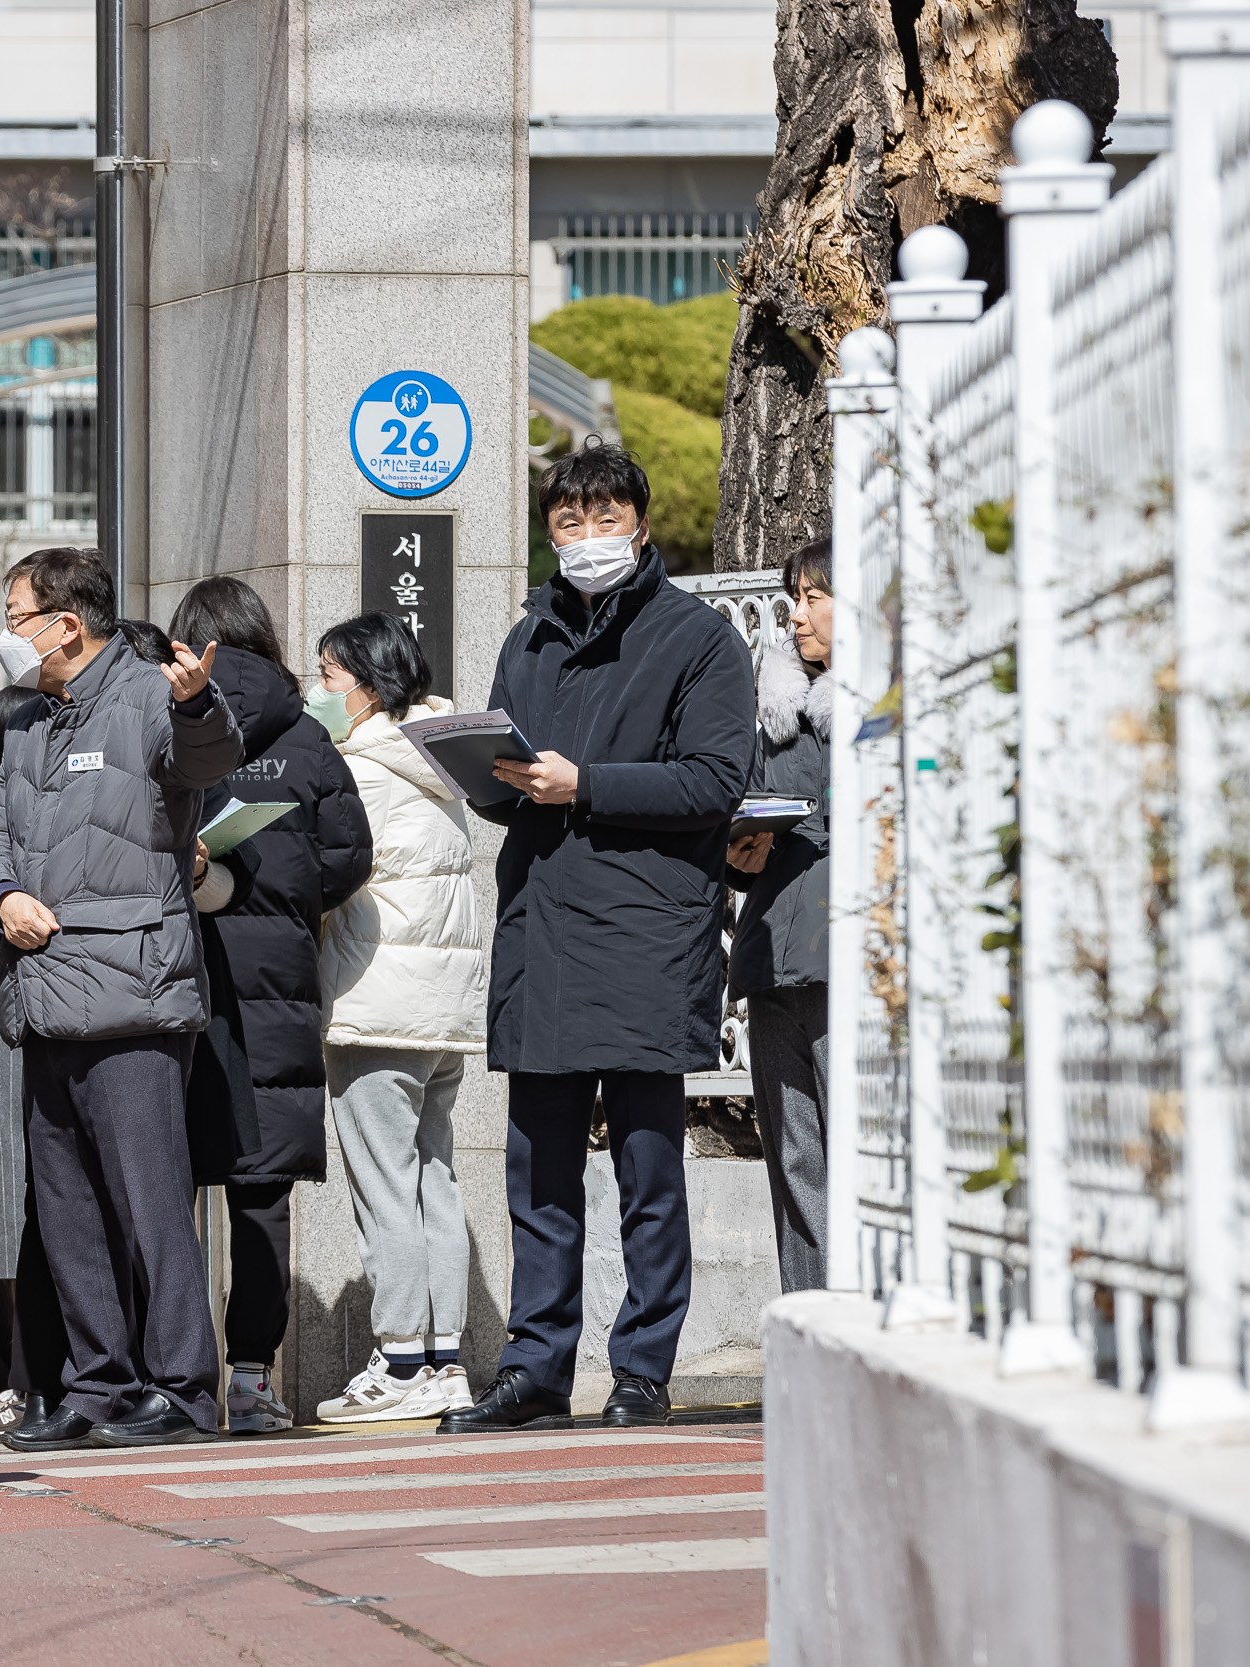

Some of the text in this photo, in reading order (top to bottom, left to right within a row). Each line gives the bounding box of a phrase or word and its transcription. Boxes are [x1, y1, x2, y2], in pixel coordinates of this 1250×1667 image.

[380, 418, 439, 458] 26
[370, 458, 450, 473] 아차산로44길
[398, 482, 421, 490] 05054
